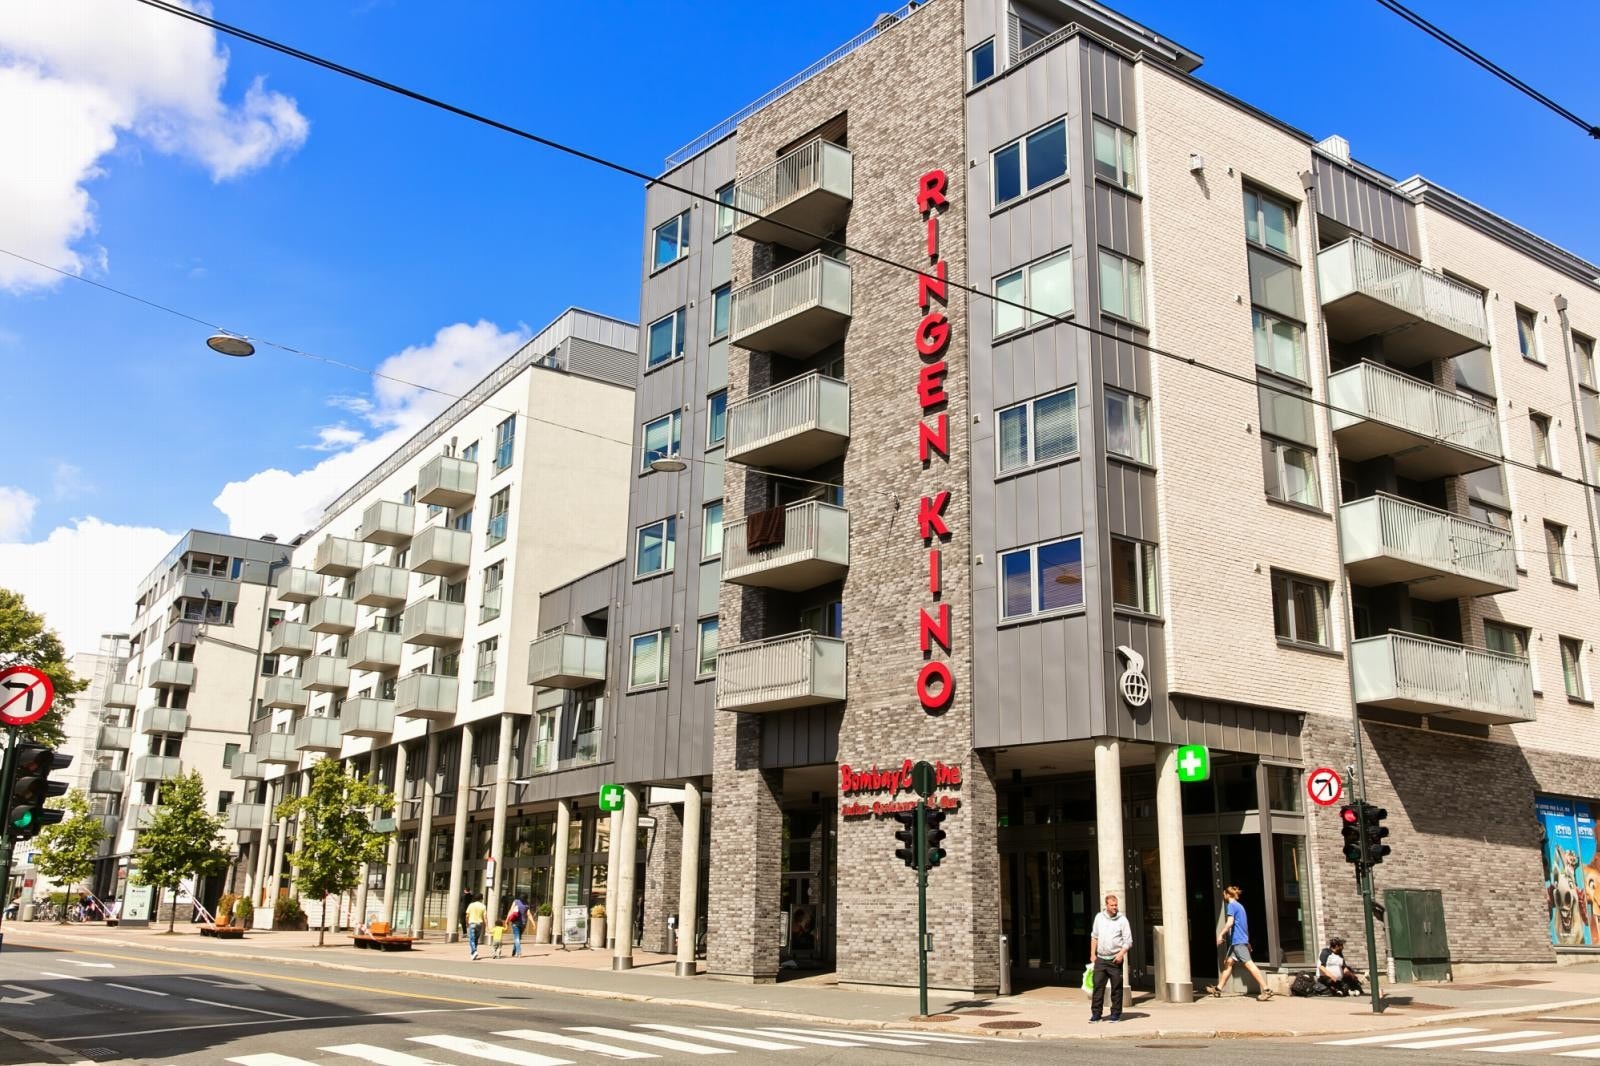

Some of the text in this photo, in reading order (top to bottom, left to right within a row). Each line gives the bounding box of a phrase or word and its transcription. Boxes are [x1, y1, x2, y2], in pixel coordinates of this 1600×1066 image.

[915, 169, 953, 708] RINGEN KINO
[841, 759, 960, 795] Bombay Cine
